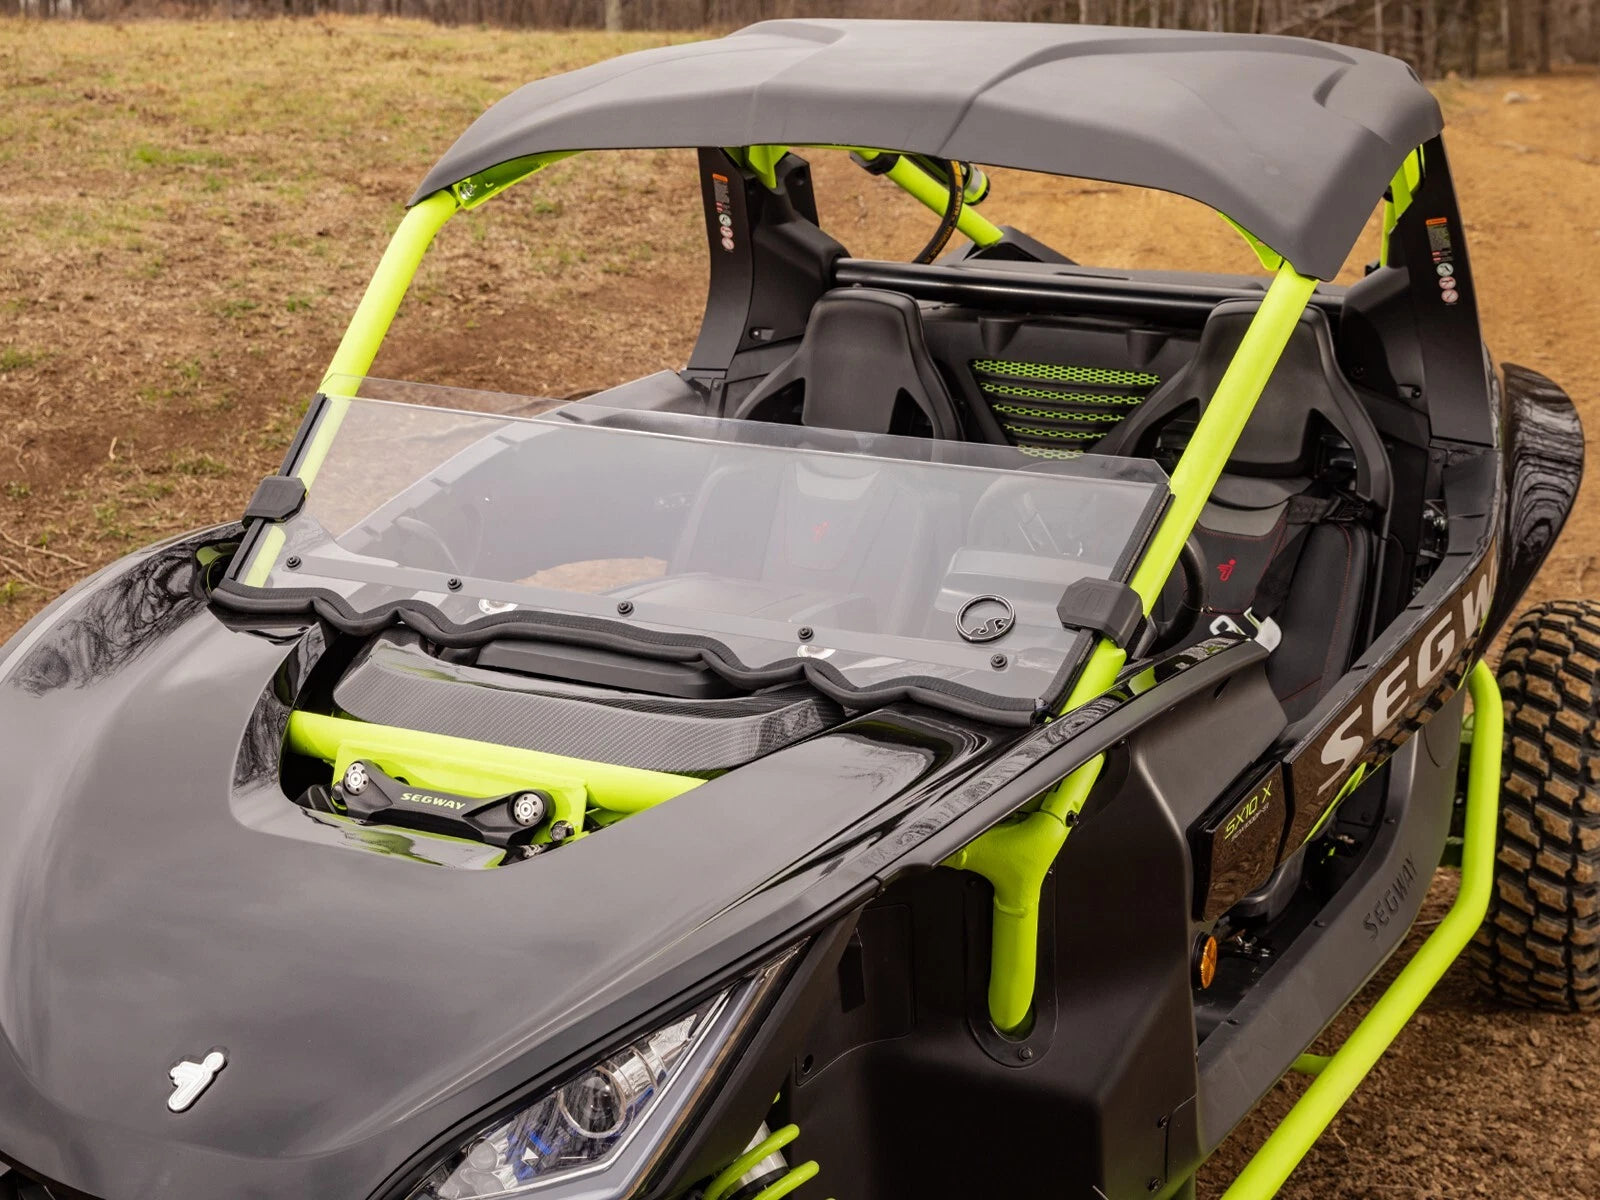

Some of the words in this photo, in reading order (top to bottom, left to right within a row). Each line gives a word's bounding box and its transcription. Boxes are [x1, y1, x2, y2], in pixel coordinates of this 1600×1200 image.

[1317, 556, 1498, 796] SEGW
[400, 792, 466, 809] SEGWAY
[1225, 796, 1258, 839] SX10
[1262, 780, 1272, 803] X
[1363, 852, 1419, 943] SEGWAY
